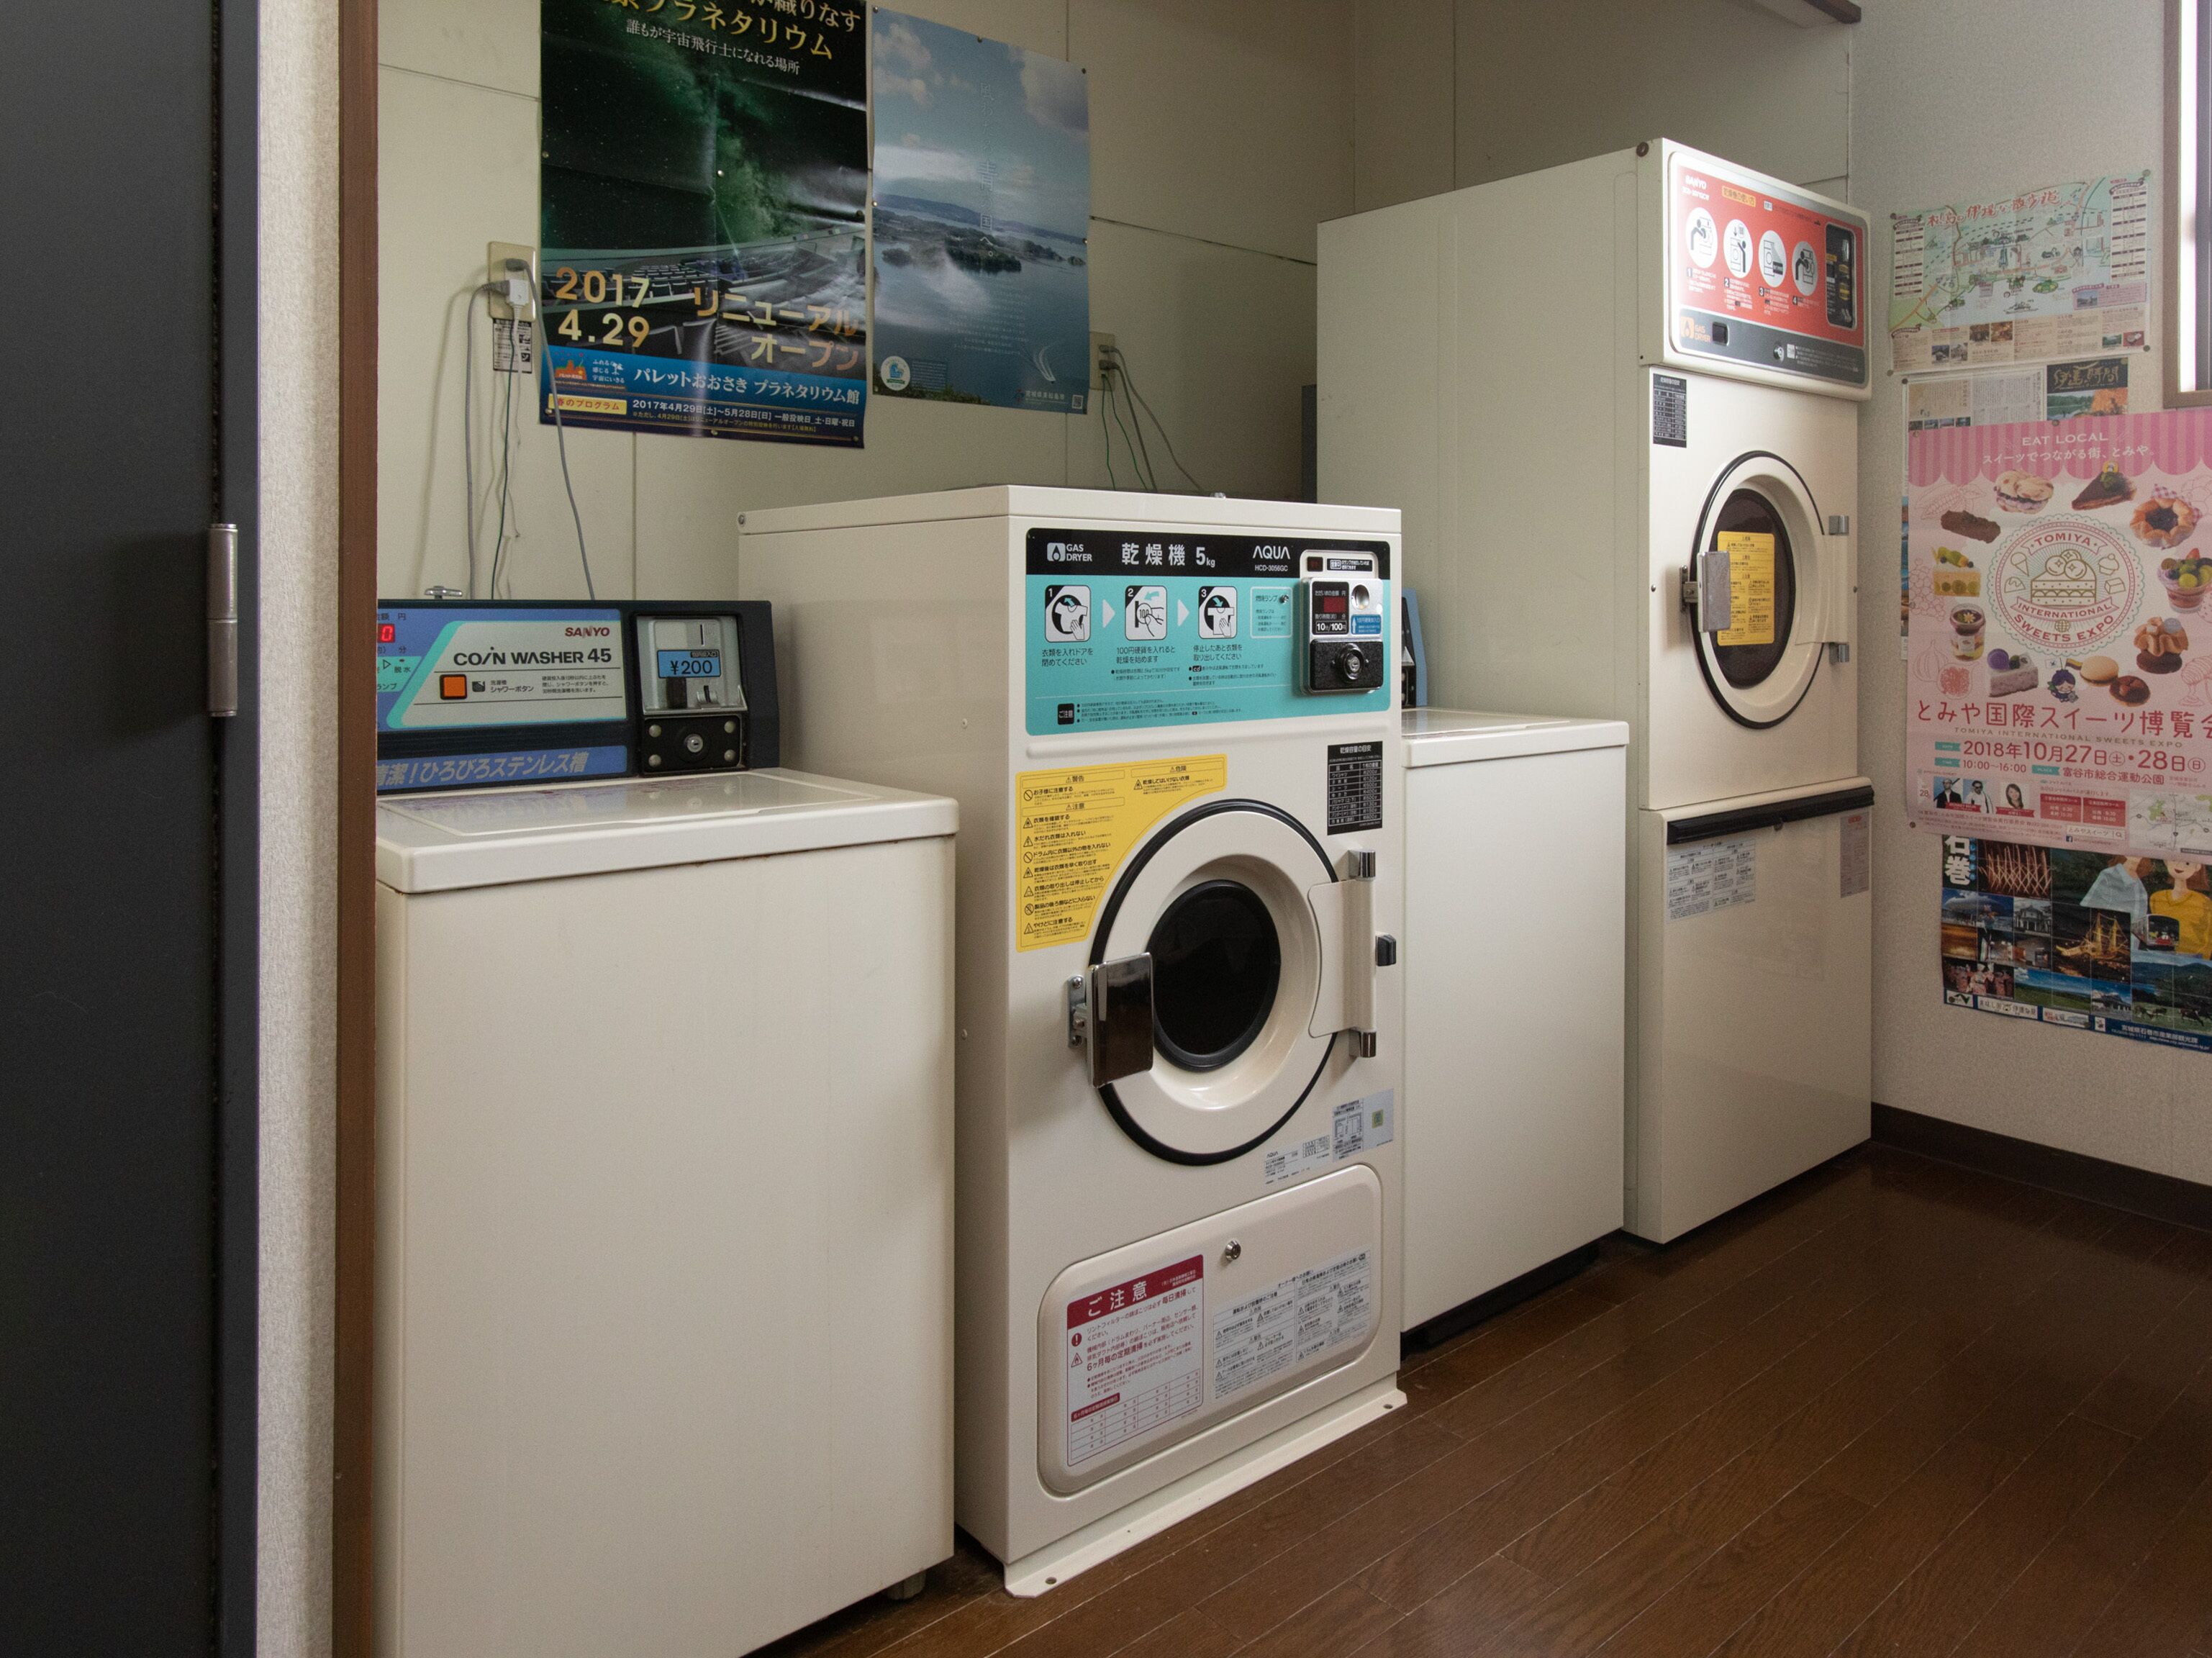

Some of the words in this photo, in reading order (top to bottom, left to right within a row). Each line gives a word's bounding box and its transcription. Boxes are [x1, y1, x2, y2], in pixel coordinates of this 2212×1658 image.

[755, 0, 861, 32] 織りなす
[614, 0, 833, 60] ラネタリウム
[626, 18, 800, 76] 誰もが宇宙飛行士になれる場所
[555, 266, 650, 309] 2017
[694, 287, 860, 338] リニューアル
[558, 309, 650, 348] 4.29
[751, 335, 858, 371] オープン
[634, 368, 747, 394] パレットおおさき
[754, 379, 860, 405] プラネタリウム館
[558, 397, 620, 411] 春のプログラム
[2022, 436, 2051, 446] EAT
[2056, 432, 2108, 444] LOCAL
[1066, 543, 1084, 552] GAS
[2034, 532, 2091, 548] TOMIYA
[1066, 553, 1092, 562] DRYER
[1122, 543, 1186, 566] 乾燥機
[1252, 545, 1291, 559] AQUA
[1048, 588, 1053, 597] 1
[1128, 588, 1134, 597] 2
[398, 612, 407, 621] 円
[2017, 602, 2112, 620] INTERNATIONAL
[381, 625, 394, 642] 0
[564, 627, 610, 638] SANYO
[2014, 614, 2071, 643] SWEETS
[2076, 614, 2115, 642] EXPO
[453, 646, 506, 666] COIN
[511, 651, 584, 665] WASHER
[587, 648, 612, 663] 45
[1041, 658, 1087, 667] 閉めてください
[670, 660, 712, 675] ¥200
[490, 684, 535, 694] シャワーボタン
[1953, 726, 1994, 736] TOMIYA
[1998, 729, 2090, 742] INTERNATIONAL
[2095, 735, 2144, 746] SWEETS
[2149, 739, 2183, 749] EXPO
[2062, 766, 2165, 786] 富谷市総合運動公園
[1033, 786, 1074, 795] お子様に注意する
[1919, 789, 1929, 797] 28
[1944, 835, 1971, 886] 石巻
[1033, 917, 1073, 928] やけどに注意する
[1087, 1279, 1147, 1318] ご注意
